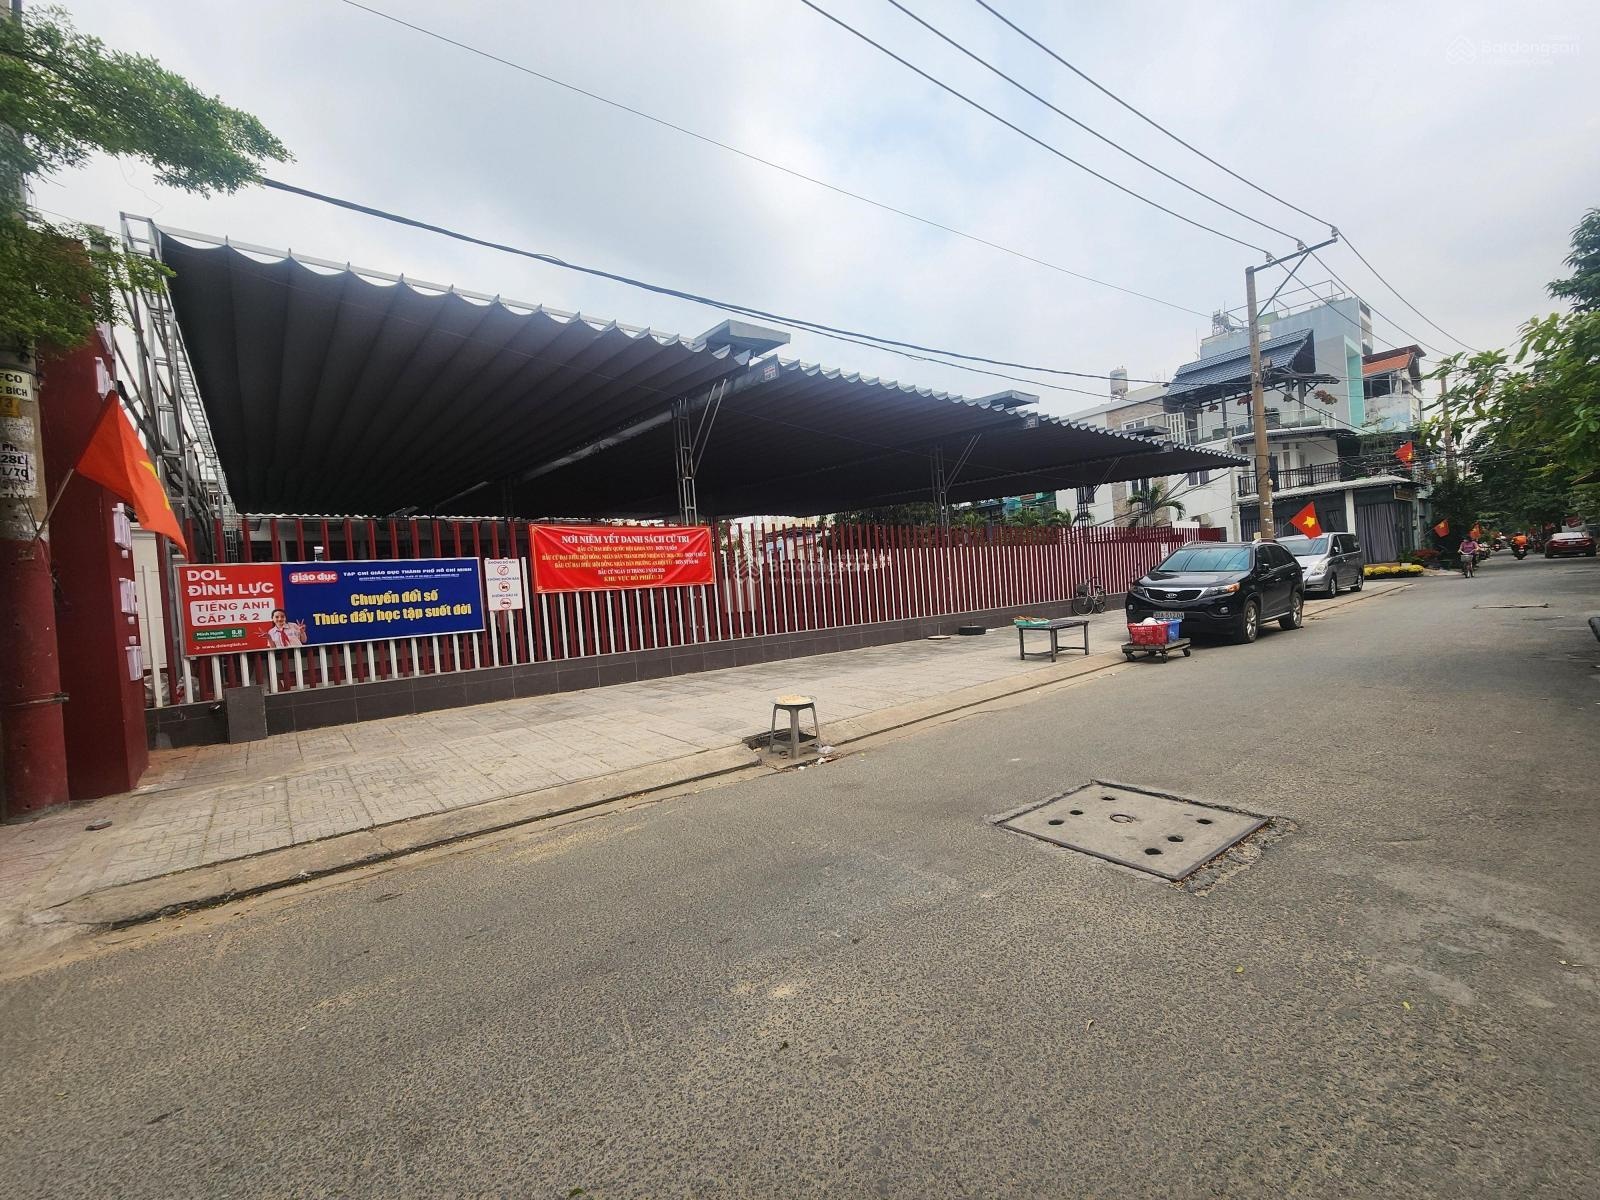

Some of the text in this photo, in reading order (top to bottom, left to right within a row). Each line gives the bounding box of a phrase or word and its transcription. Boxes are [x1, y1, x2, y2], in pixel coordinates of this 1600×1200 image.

[562, 534, 578, 544] NƠI
[603, 533, 619, 543] YẾT
[621, 535, 644, 543] DANH
[645, 533, 664, 543] SÁCH
[677, 535, 689, 543] TRI
[187, 570, 226, 581] DOL
[291, 572, 337, 583] giáo dục
[188, 582, 274, 596] ĐÌNH LỰC
[351, 588, 439, 606] Chuyển đổi số
[196, 601, 270, 612] TIẾNG ANH
[197, 613, 226, 624] CẤP
[239, 613, 247, 621] &
[252, 612, 259, 621] 2
[313, 603, 472, 626] Thúc đẩy học tập suốt đời
